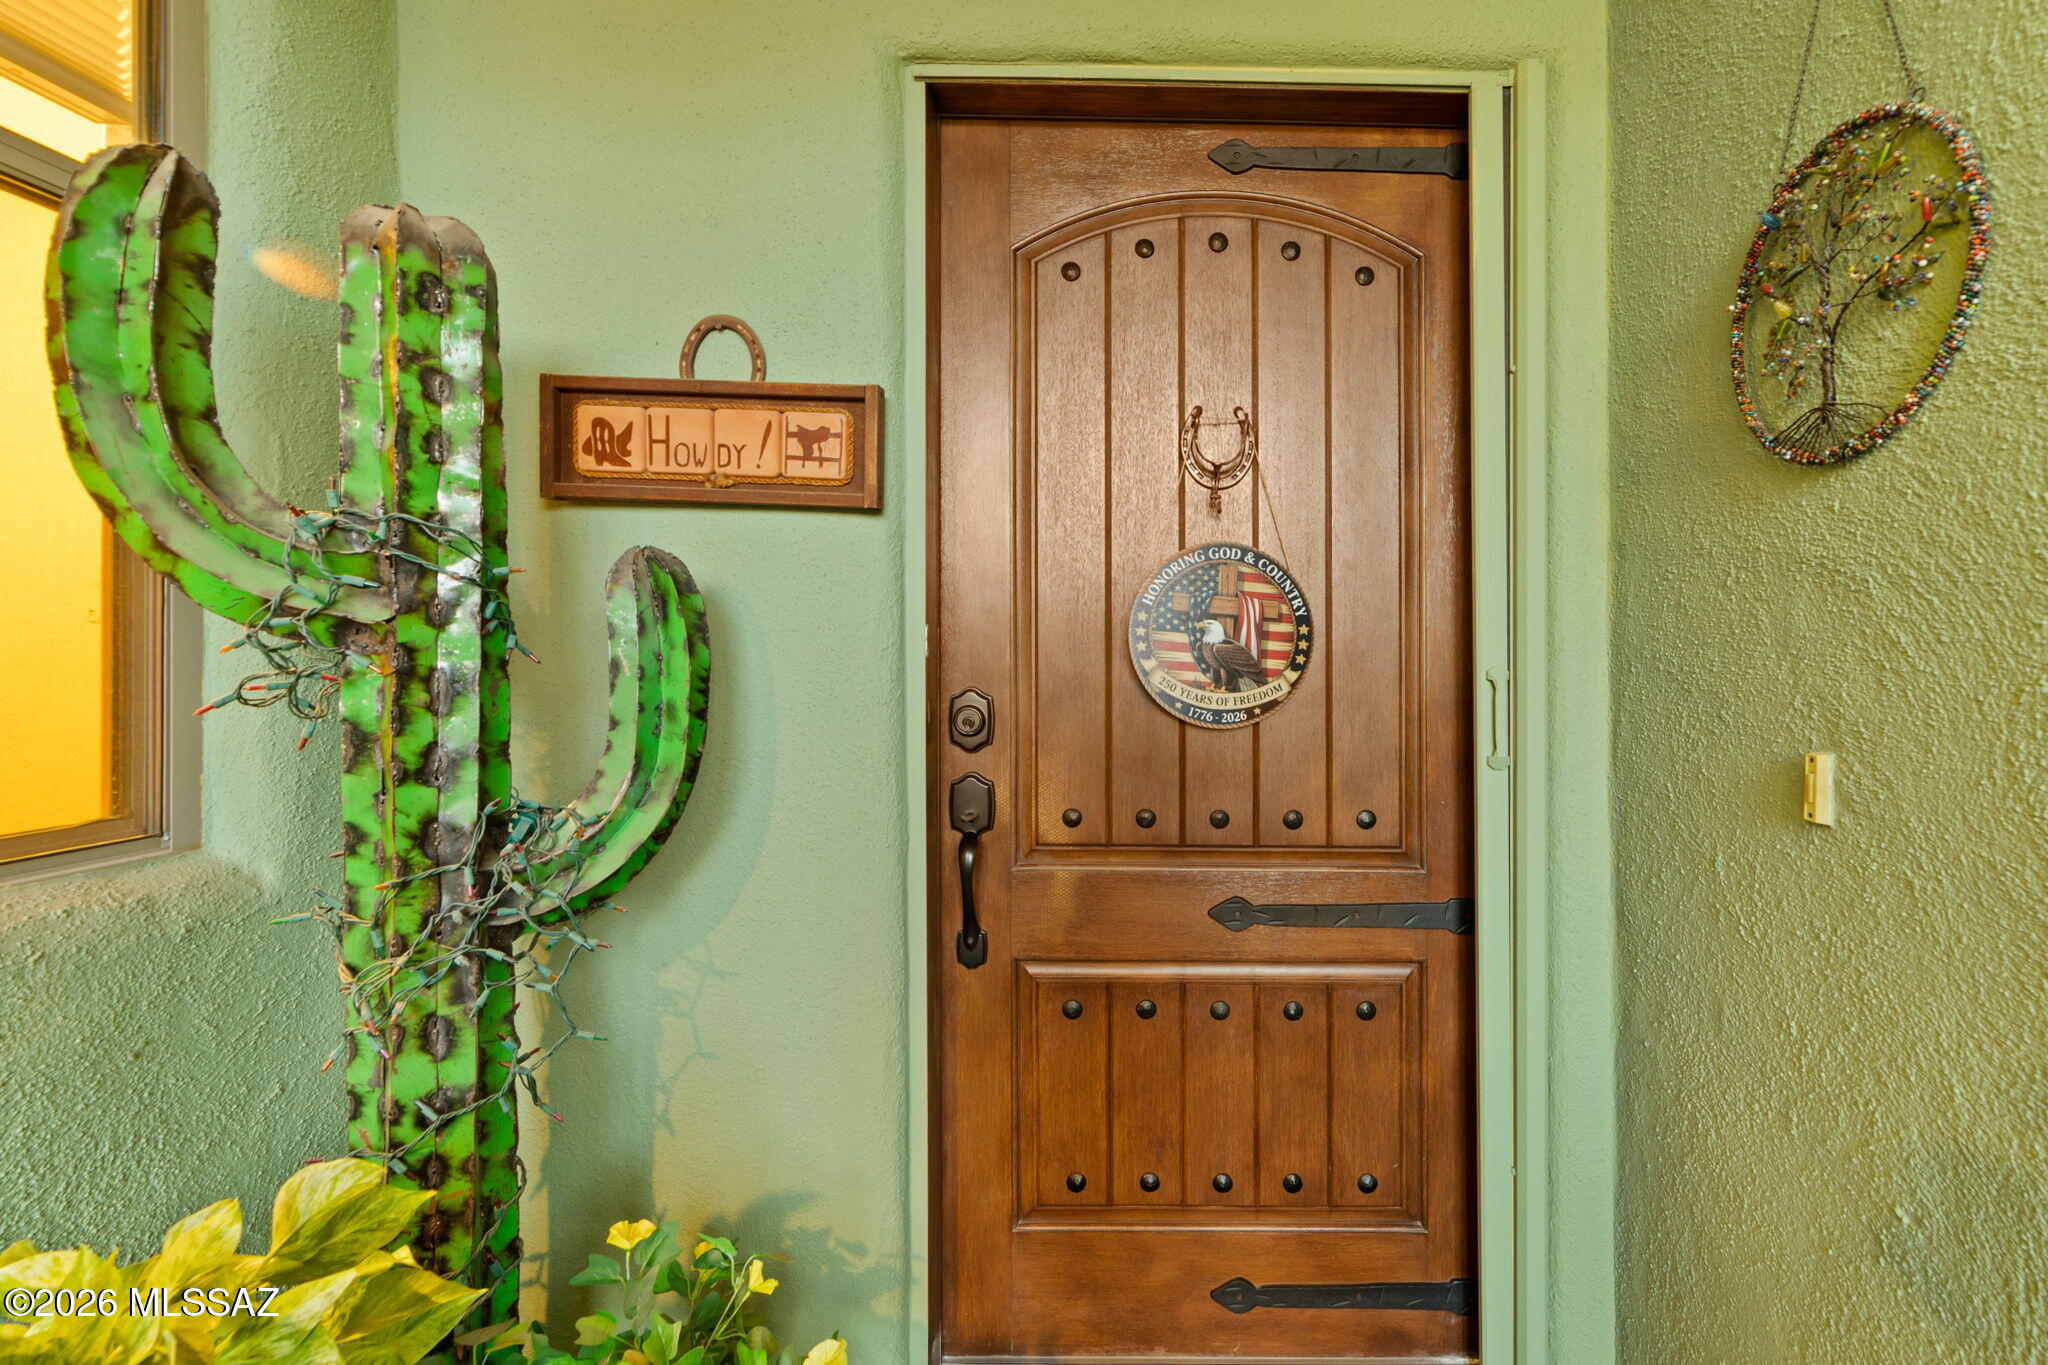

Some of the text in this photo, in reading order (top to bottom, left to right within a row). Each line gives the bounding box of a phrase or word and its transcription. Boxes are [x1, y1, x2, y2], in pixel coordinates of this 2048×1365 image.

[1141, 546, 1308, 618] HONORING GOD & COUNTRY
[1158, 675, 1283, 707] 250 YEARS OF FREEDOM
[1188, 707, 1213, 722] 1776
[1221, 709, 1247, 723] 2026
